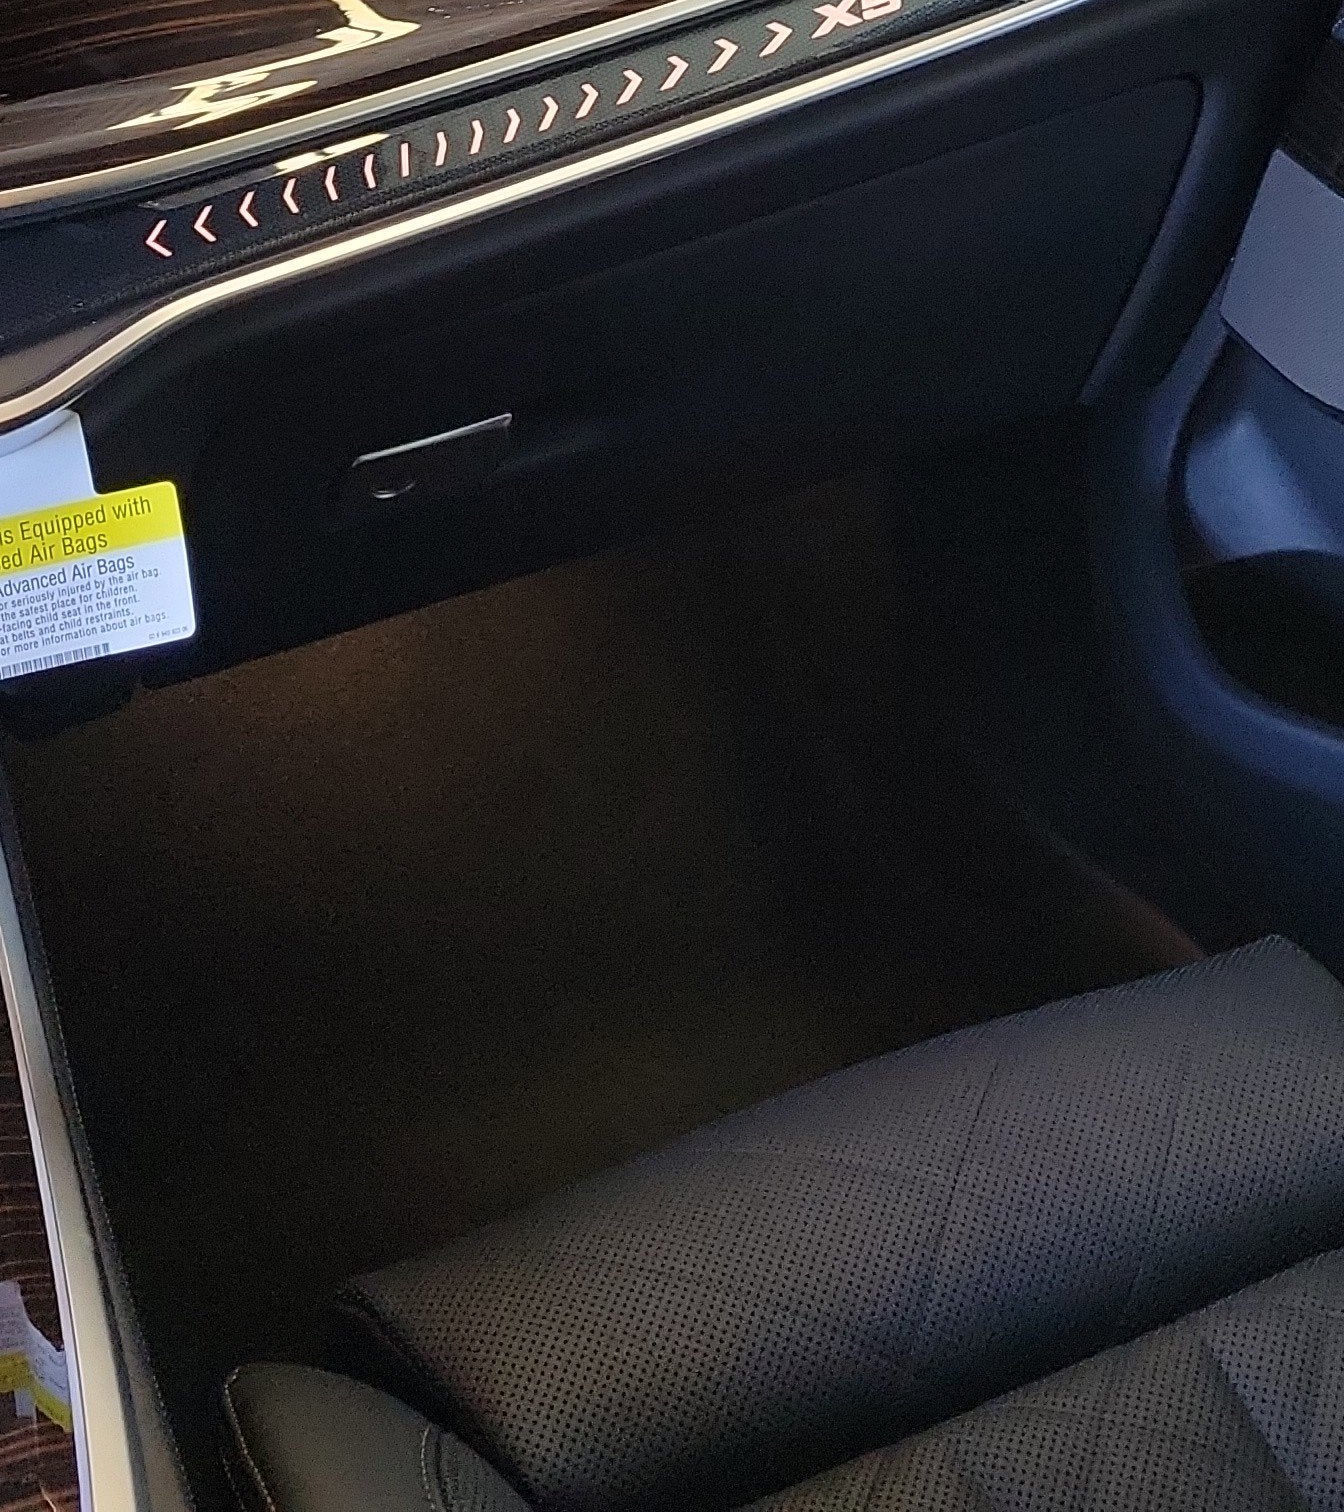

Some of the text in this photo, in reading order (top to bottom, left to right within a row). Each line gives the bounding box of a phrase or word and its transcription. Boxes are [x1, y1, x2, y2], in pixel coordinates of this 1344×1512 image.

[19, 504, 106, 541] Equipped
[112, 496, 151, 520] with
[30, 542, 55, 564] Air
[62, 533, 108, 556] Bags
[72, 564, 92, 582] Air
[97, 556, 135, 575] Bags
[1, 609, 16, 621] the
[19, 603, 48, 618] safest
[51, 597, 76, 611] place
[80, 593, 92, 603] for
[96, 584, 137, 600] children.
[11, 590, 54, 608] seriously
[58, 583, 91, 598] injured
[94, 579, 105, 590] by
[108, 576, 123, 586] the
[127, 572, 139, 582] air
[142, 568, 162, 578] bag.
[12, 630, 35, 643] belts
[39, 623, 56, 636] and
[59, 618, 82, 631] child
[86, 608, 134, 625] restraints.
[35, 611, 58, 625] child
[62, 606, 82, 619] seat
[84, 604, 93, 613] in
[96, 600, 111, 611] the
[114, 595, 140, 608] front.
[14, 640, 38, 653] more
[42, 626, 97, 646] information
[101, 619, 127, 633] about
[130, 617, 141, 627] air
[145, 612, 169, 623] bags.
